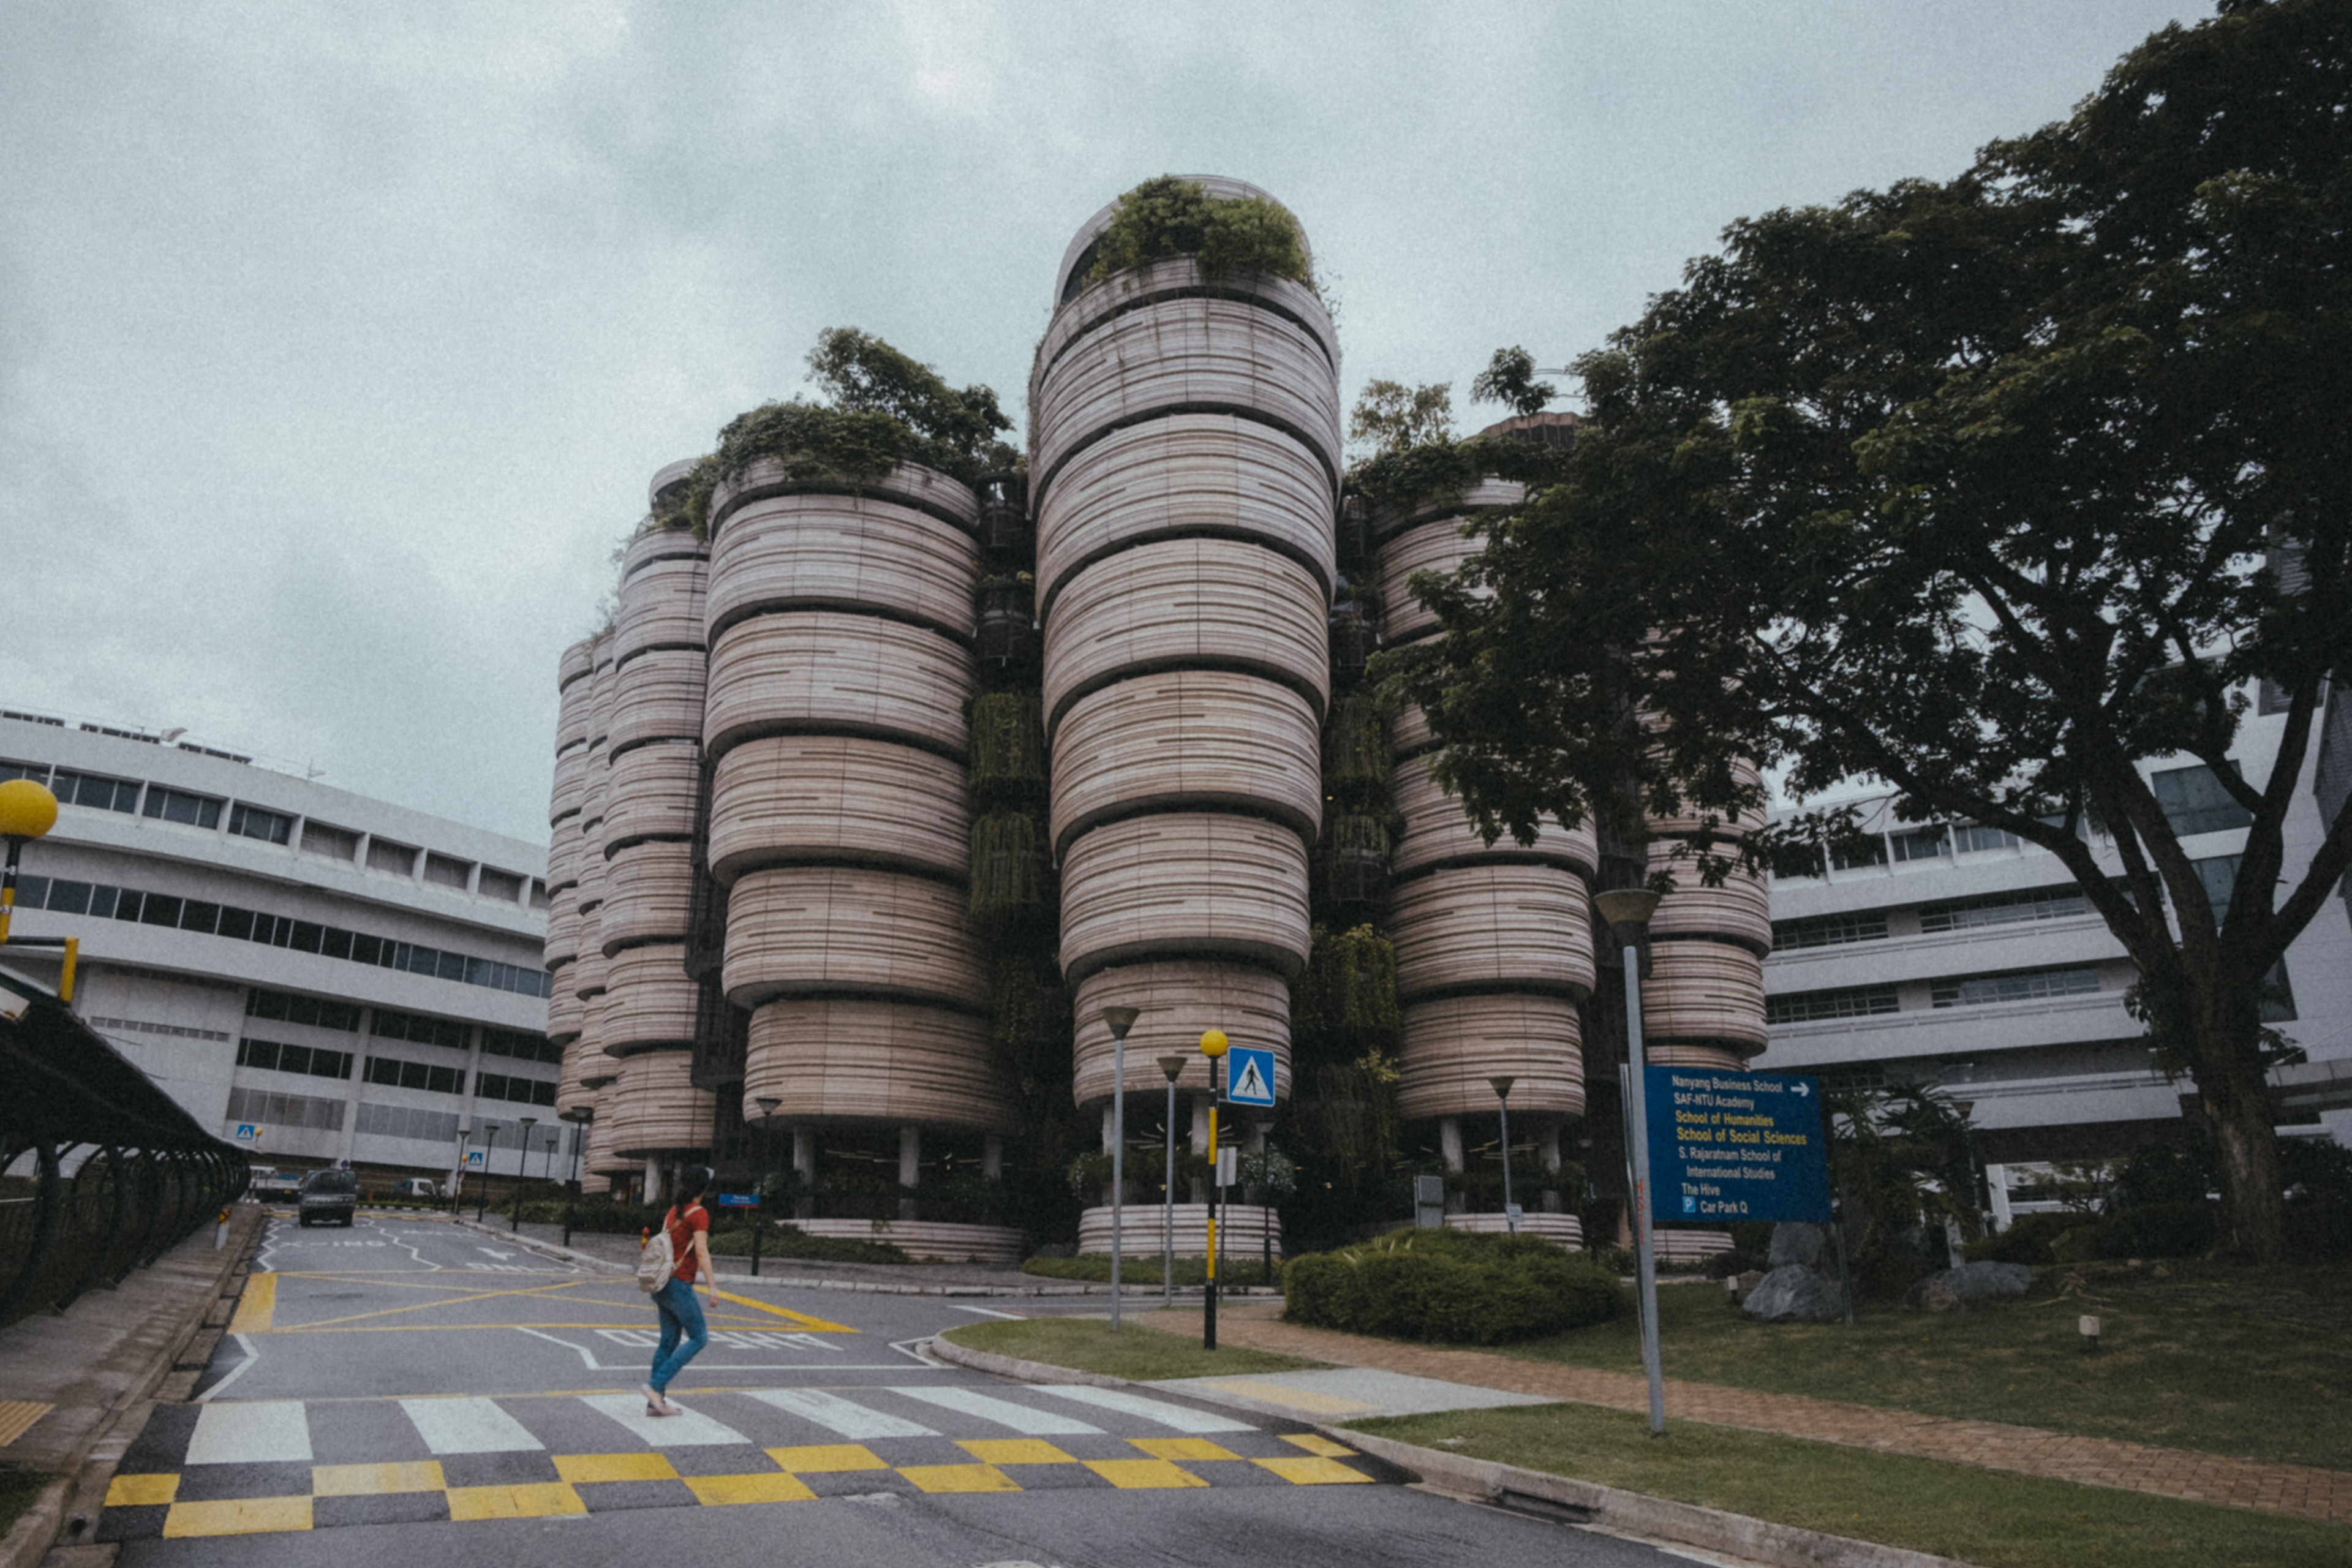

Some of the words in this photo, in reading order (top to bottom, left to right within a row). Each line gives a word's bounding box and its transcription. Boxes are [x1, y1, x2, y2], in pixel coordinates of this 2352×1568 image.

[1672, 1075, 1711, 1091] Nanyang
[1713, 1077, 1752, 1091] Business
[1754, 1079, 1783, 1093] School
[1674, 1093, 1713, 1106] SAF-NTU
[1715, 1095, 1754, 1111] Academy
[1675, 1110, 1708, 1124] School
[1711, 1112, 1721, 1125] of
[1724, 1113, 1774, 1127] Humanities
[1676, 1127, 1712, 1141] School
[1716, 1129, 1726, 1142] of
[1729, 1130, 1760, 1144] Social
[1764, 1131, 1807, 1145] Sciences
[1678, 1147, 1687, 1159] S.
[1690, 1147, 1739, 1162] Rajaratnam
[1741, 1149, 1770, 1161] School
[1773, 1150, 1782, 1162] of
[1686, 1165, 1741, 1178] International
[1743, 1167, 1775, 1180] Studies
[1682, 1183, 1698, 1195] The
[1700, 1183, 1720, 1196] Hive
[1700, 1200, 1716, 1213] Car
[1718, 1200, 1738, 1213] Park
[1740, 1202, 1748, 1214] Q
